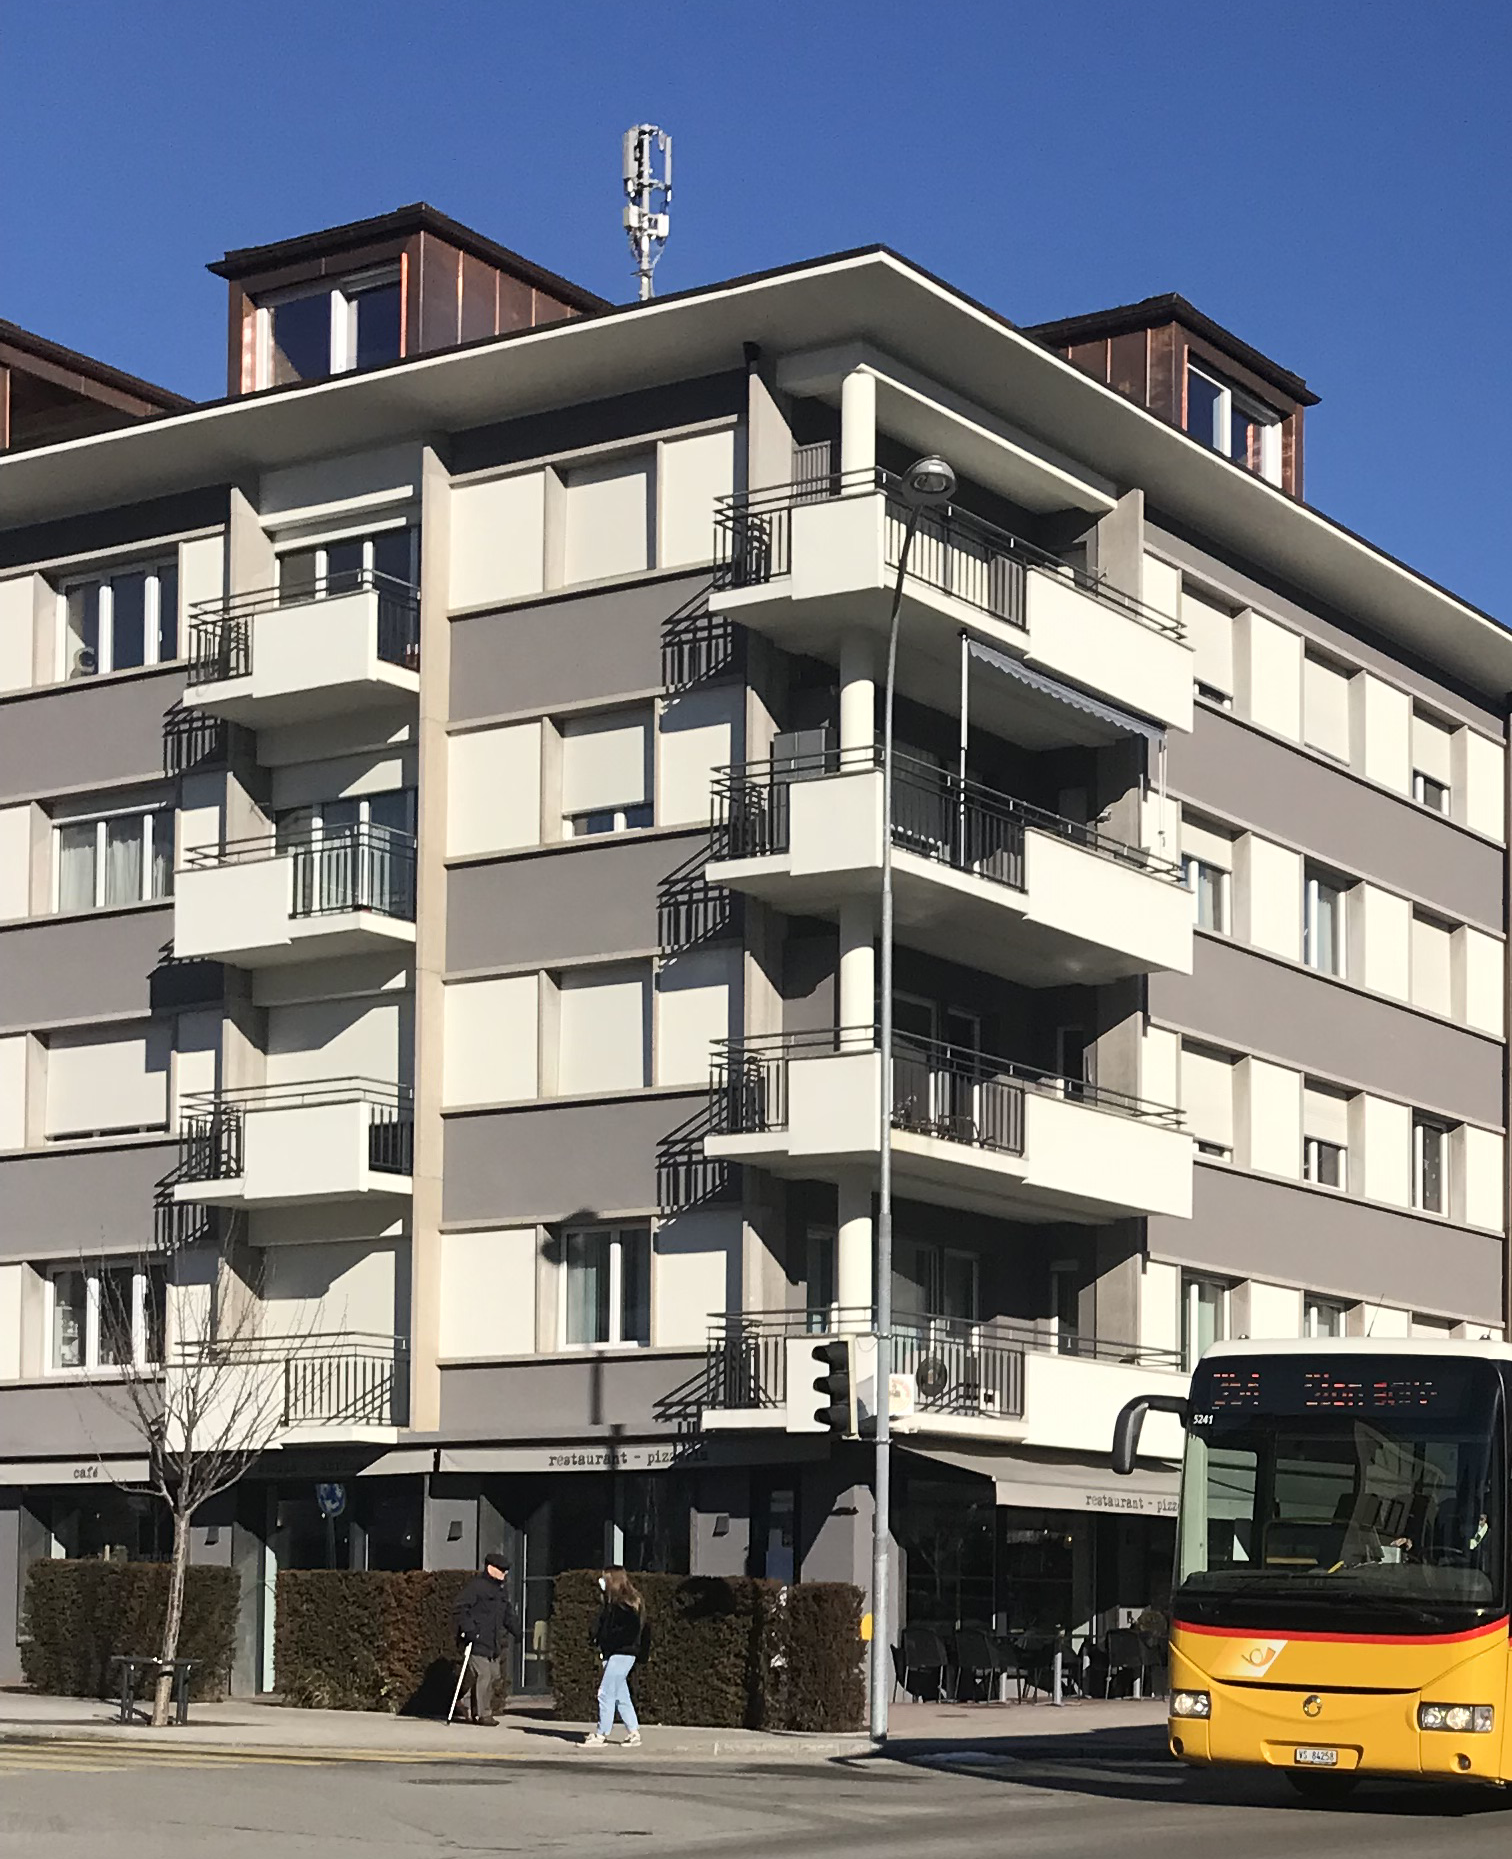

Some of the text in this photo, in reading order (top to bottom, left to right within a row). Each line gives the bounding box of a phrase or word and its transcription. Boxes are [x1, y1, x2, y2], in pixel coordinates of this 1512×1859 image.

[1193, 1414, 1214, 1425] 5241
[548, 1451, 628, 1467] restaurant
[73, 1467, 98, 1478] café
[1085, 1494, 1144, 1509] restaurant
[1299, 1751, 1308, 1760] VS
